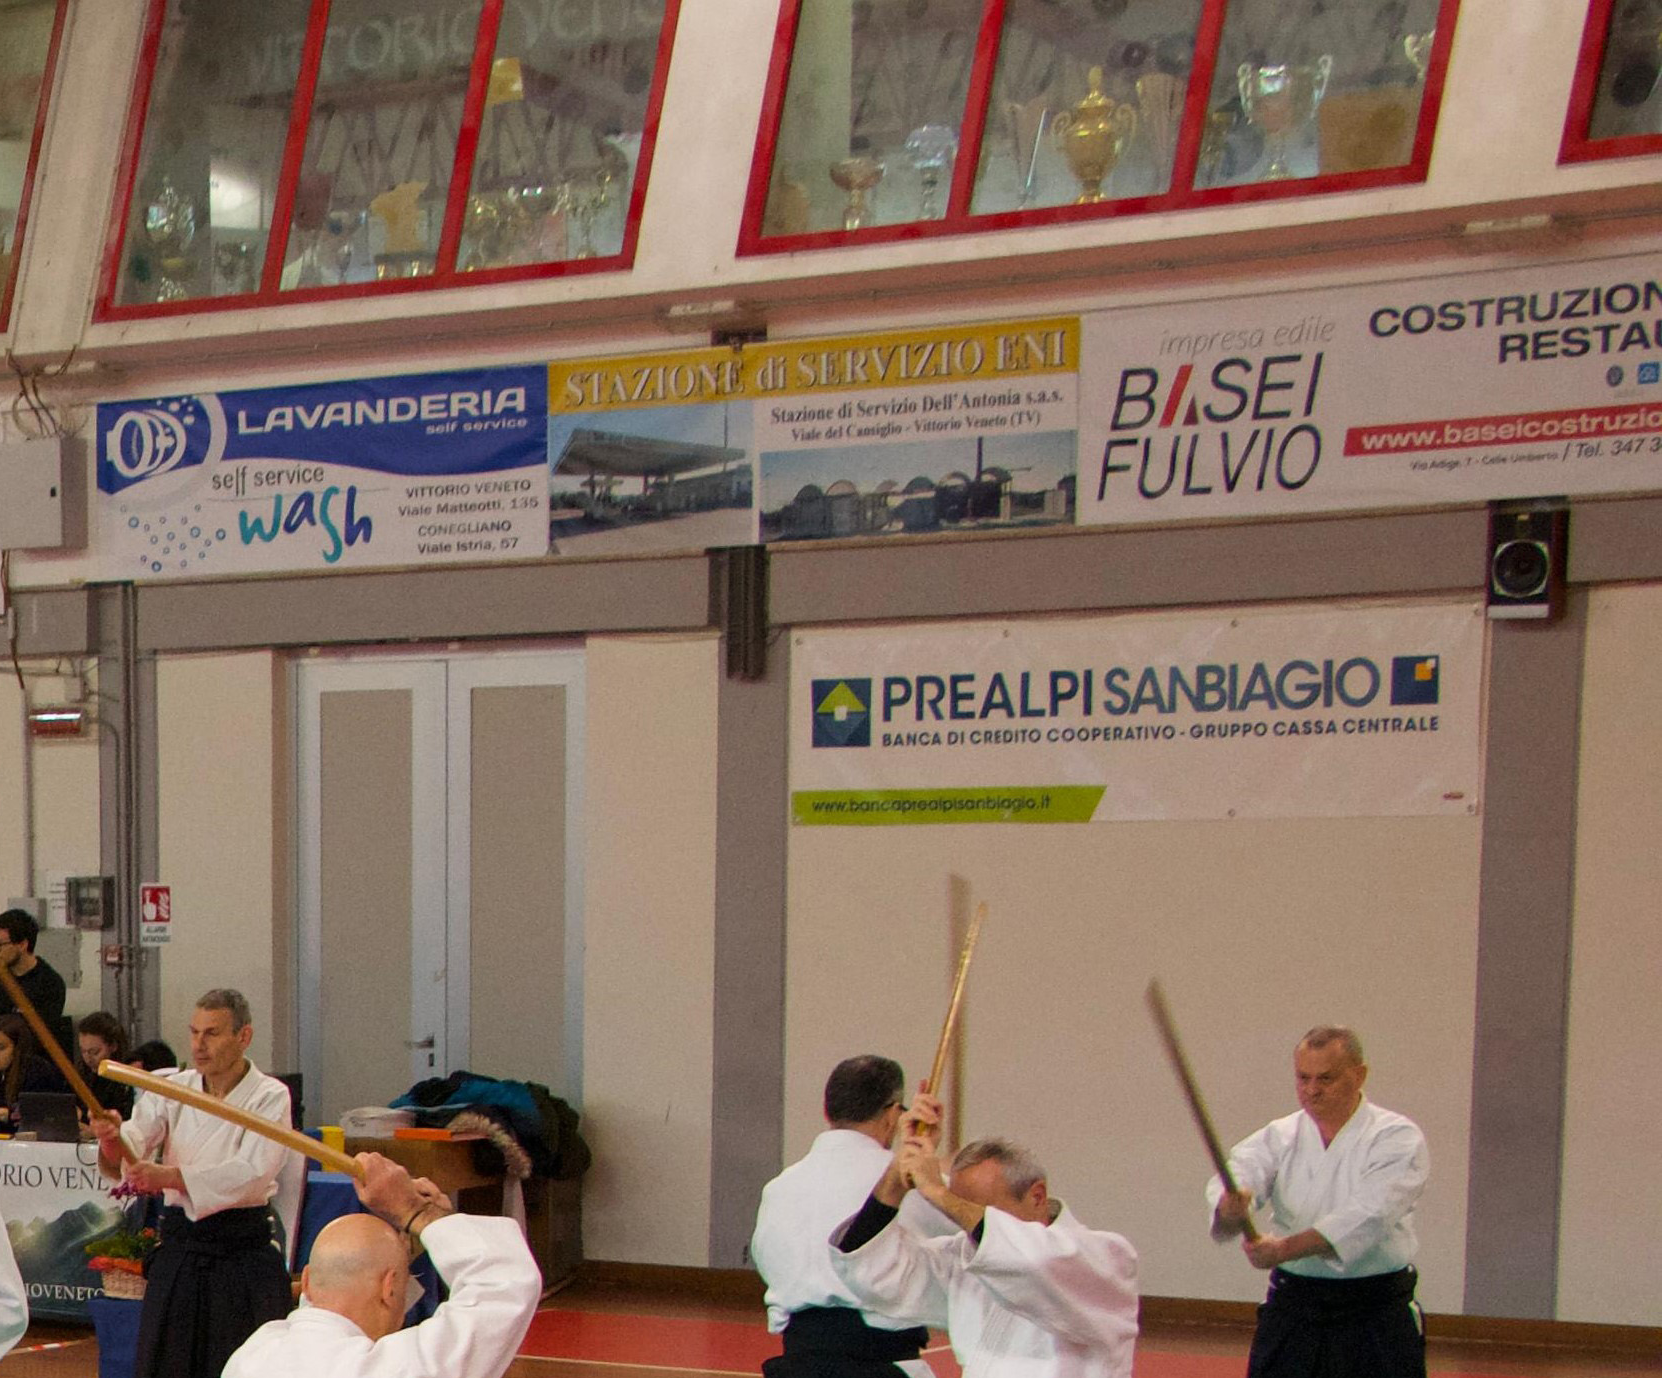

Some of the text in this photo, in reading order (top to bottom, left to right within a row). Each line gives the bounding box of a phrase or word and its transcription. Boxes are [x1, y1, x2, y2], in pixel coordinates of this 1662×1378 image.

[1159, 317, 1335, 357] impresa edile
[1498, 321, 1662, 364] RESTA
[565, 329, 1066, 407] STAZIONE di SERVIZIO ENI
[1109, 352, 1324, 432] BASEI
[237, 387, 526, 435] LAVANDERIA
[425, 417, 528, 434] self service
[770, 405, 835, 426] Stazione
[838, 401, 854, 420] di
[857, 397, 919, 419] Servizio
[790, 426, 822, 444] Viale
[824, 423, 844, 441] del
[914, 413, 963, 433] Vittorio
[966, 411, 1007, 430] Veneto
[1009, 407, 1040, 429] (TV)
[1097, 423, 1322, 501] FULVIO
[1576, 443, 1603, 459] Tel.
[1611, 437, 1644, 456] 347
[212, 465, 324, 496] self service
[406, 479, 532, 498] VITTORIO VENETO
[238, 484, 373, 564] wash
[398, 504, 432, 517] Viale
[417, 519, 512, 536] CONEGLIANO
[417, 541, 452, 555] Viale
[500, 536, 519, 551] 57
[882, 656, 1381, 722] PREALPI SANBIAGIO
[882, 731, 941, 748] BANCA
[947, 730, 966, 745] DI
[968, 728, 1041, 744] CREDITO
[1046, 725, 1176, 743] COOPERATIVO
[1190, 722, 1269, 740] GRUPPO
[1273, 719, 1338, 737] CASSA
[1343, 716, 1440, 735] CENTRALE
[811, 793, 1051, 815] www.bancaprealpisanbiagio.it
